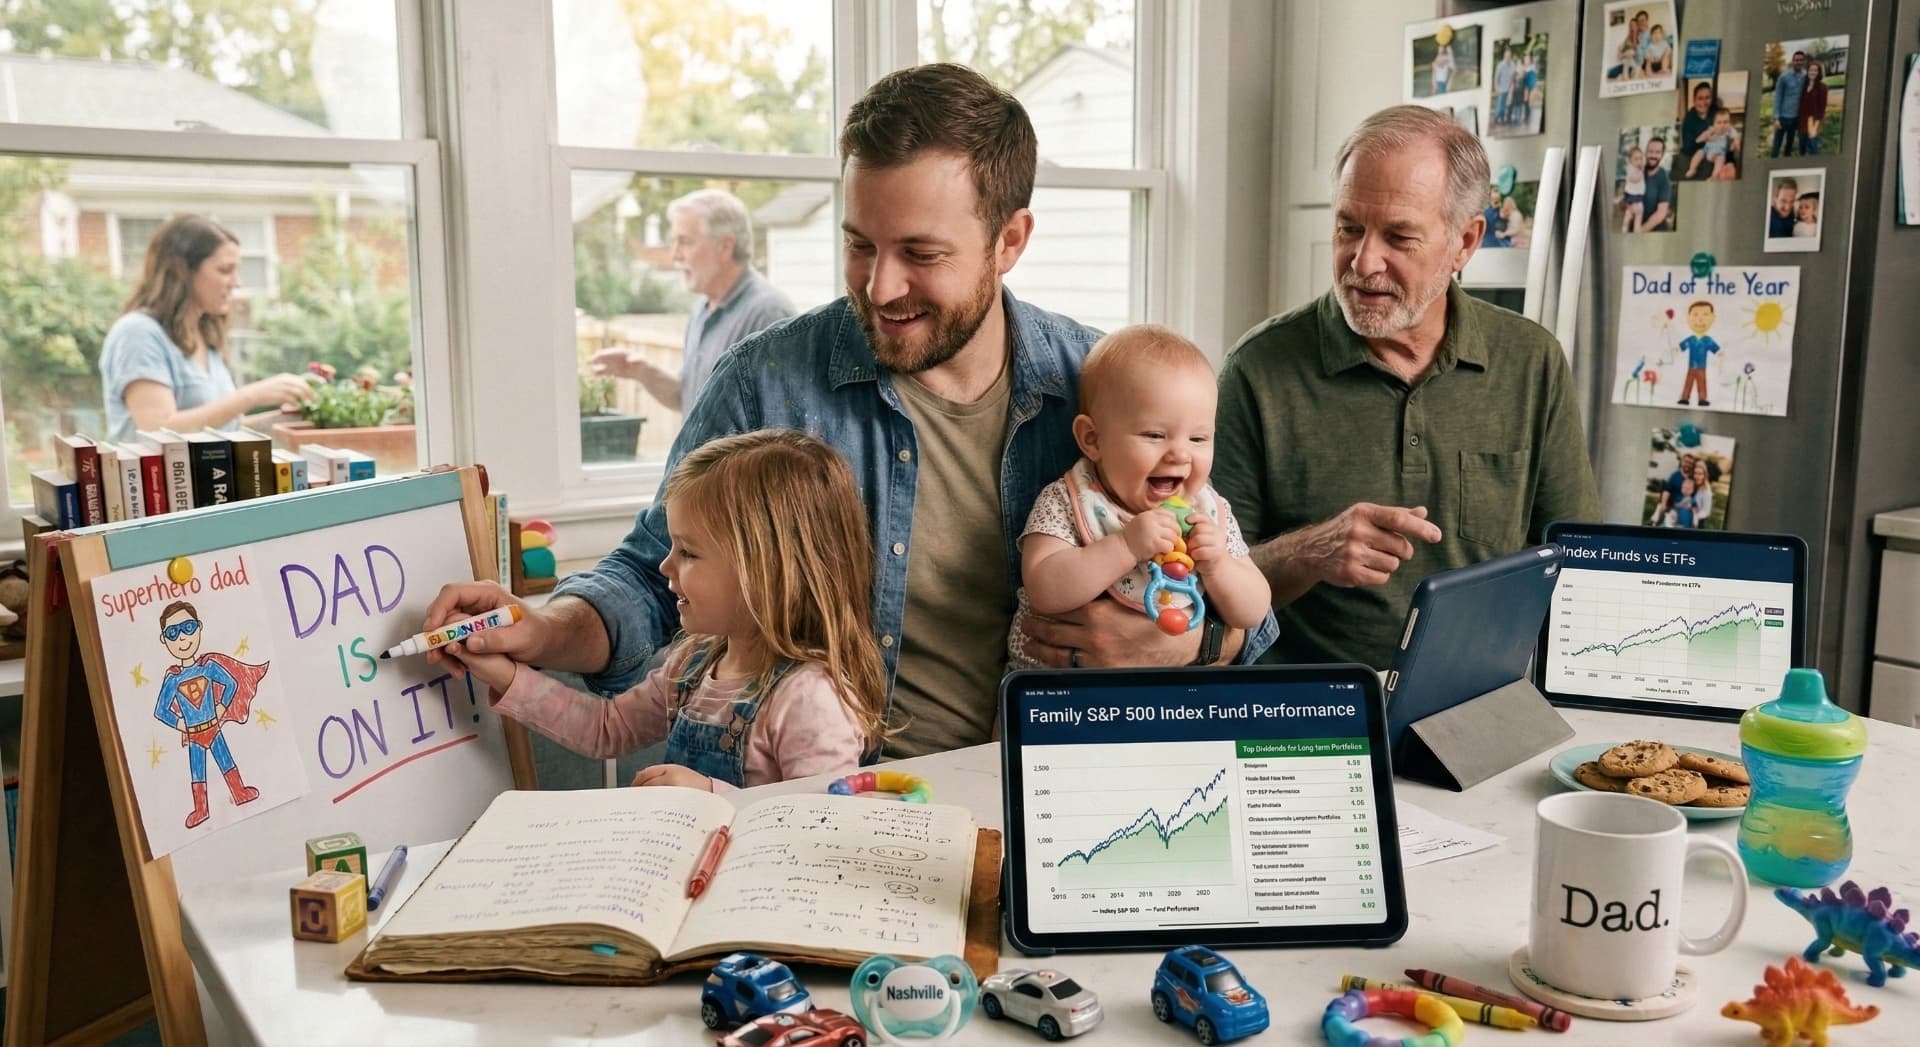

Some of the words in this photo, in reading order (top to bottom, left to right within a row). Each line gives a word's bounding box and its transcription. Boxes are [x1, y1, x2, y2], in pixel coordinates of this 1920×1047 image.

[1632, 271, 1672, 294] Dad
[1679, 275, 1696, 294] of
[1706, 272, 1736, 295] the
[1743, 271, 1790, 295] Year
[1562, 545, 1597, 559] Index
[1601, 548, 1641, 562] Funds
[1644, 553, 1659, 563] vs
[1663, 552, 1696, 566] ETFs
[101, 574, 201, 622] superhero
[210, 554, 249, 591] dad
[280, 545, 405, 638] DAD
[337, 637, 377, 688] IS
[317, 699, 389, 779] ON
[401, 670, 480, 744] IT!
[1029, 707, 1082, 726] Family
[1087, 707, 1120, 722] S&P
[1126, 706, 1155, 721] 500
[1160, 705, 1204, 720] Index
[1209, 704, 1248, 719] Fund
[1253, 703, 1356, 718] Performance
[1243, 745, 1255, 754] Top
[1297, 743, 1314, 753] Long
[1036, 812, 1052, 820] 1,500
[1037, 836, 1053, 844] 1,000
[1560, 883, 1670, 932] Dad.
[886, 984, 944, 1001] Nashville
